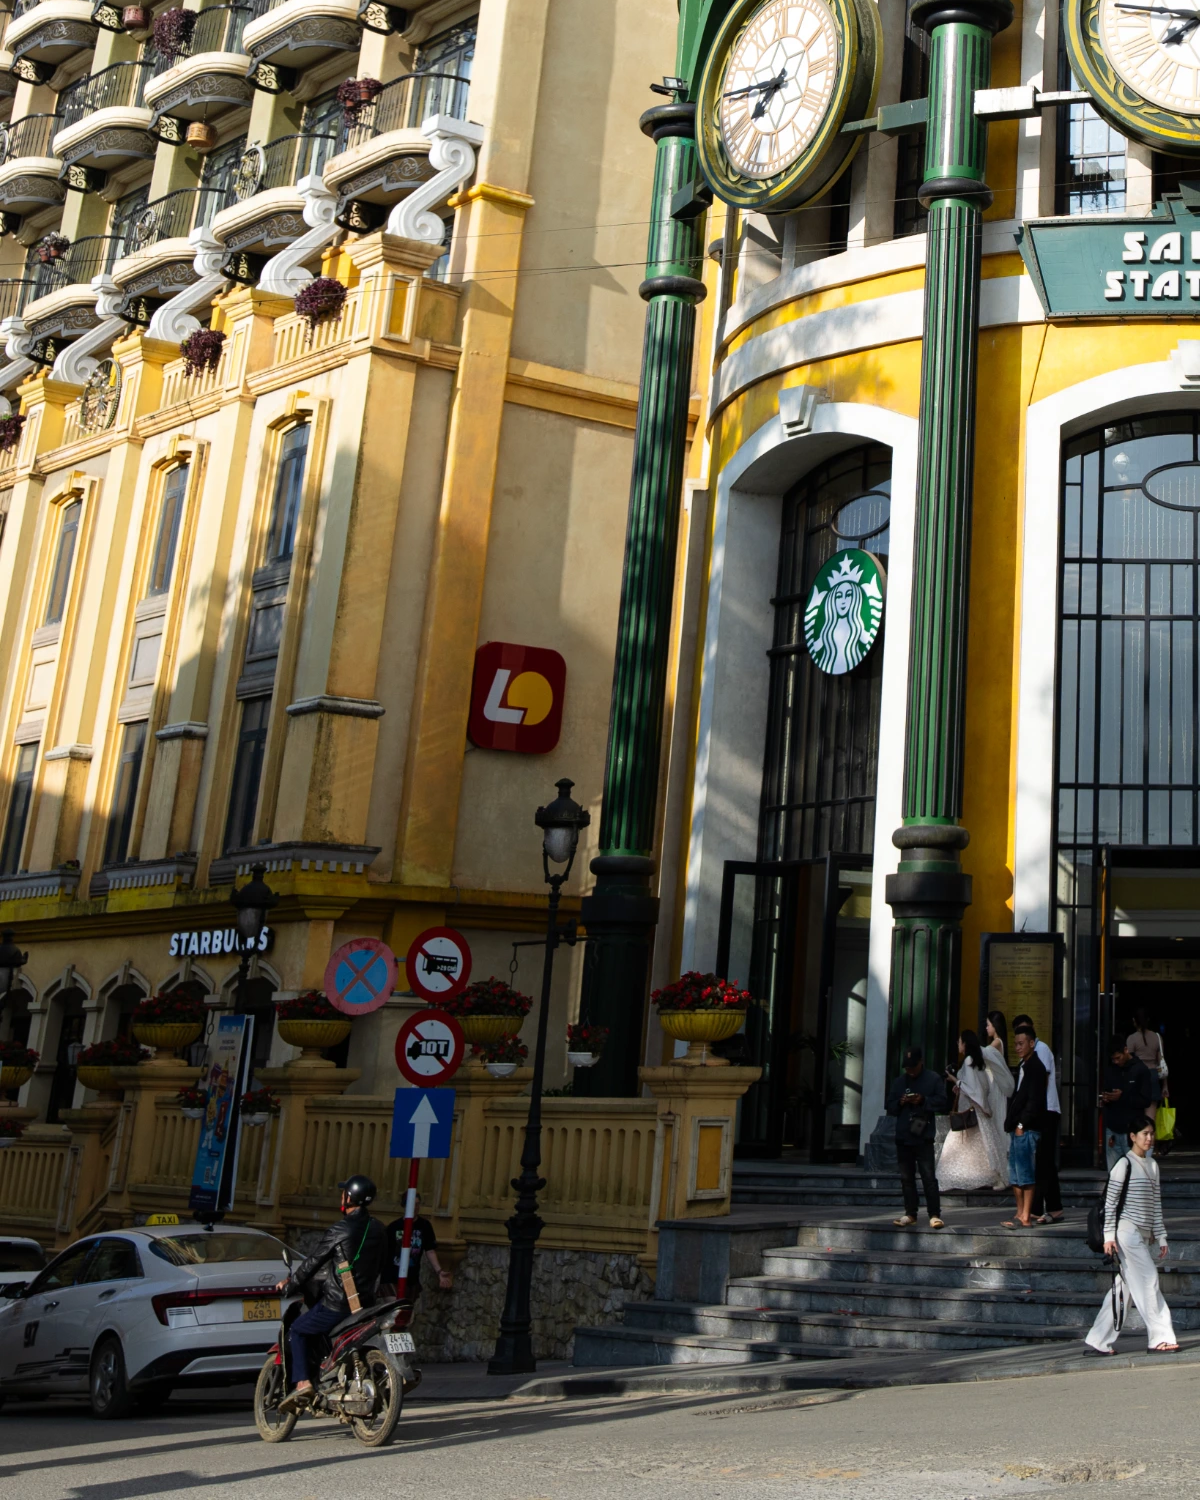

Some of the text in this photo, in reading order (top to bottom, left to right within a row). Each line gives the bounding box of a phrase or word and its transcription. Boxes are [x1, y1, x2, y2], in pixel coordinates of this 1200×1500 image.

[419, 1041, 448, 1055] 10T
[157, 1216, 176, 1224] TAXI
[247, 1309, 277, 1320] 049.31
